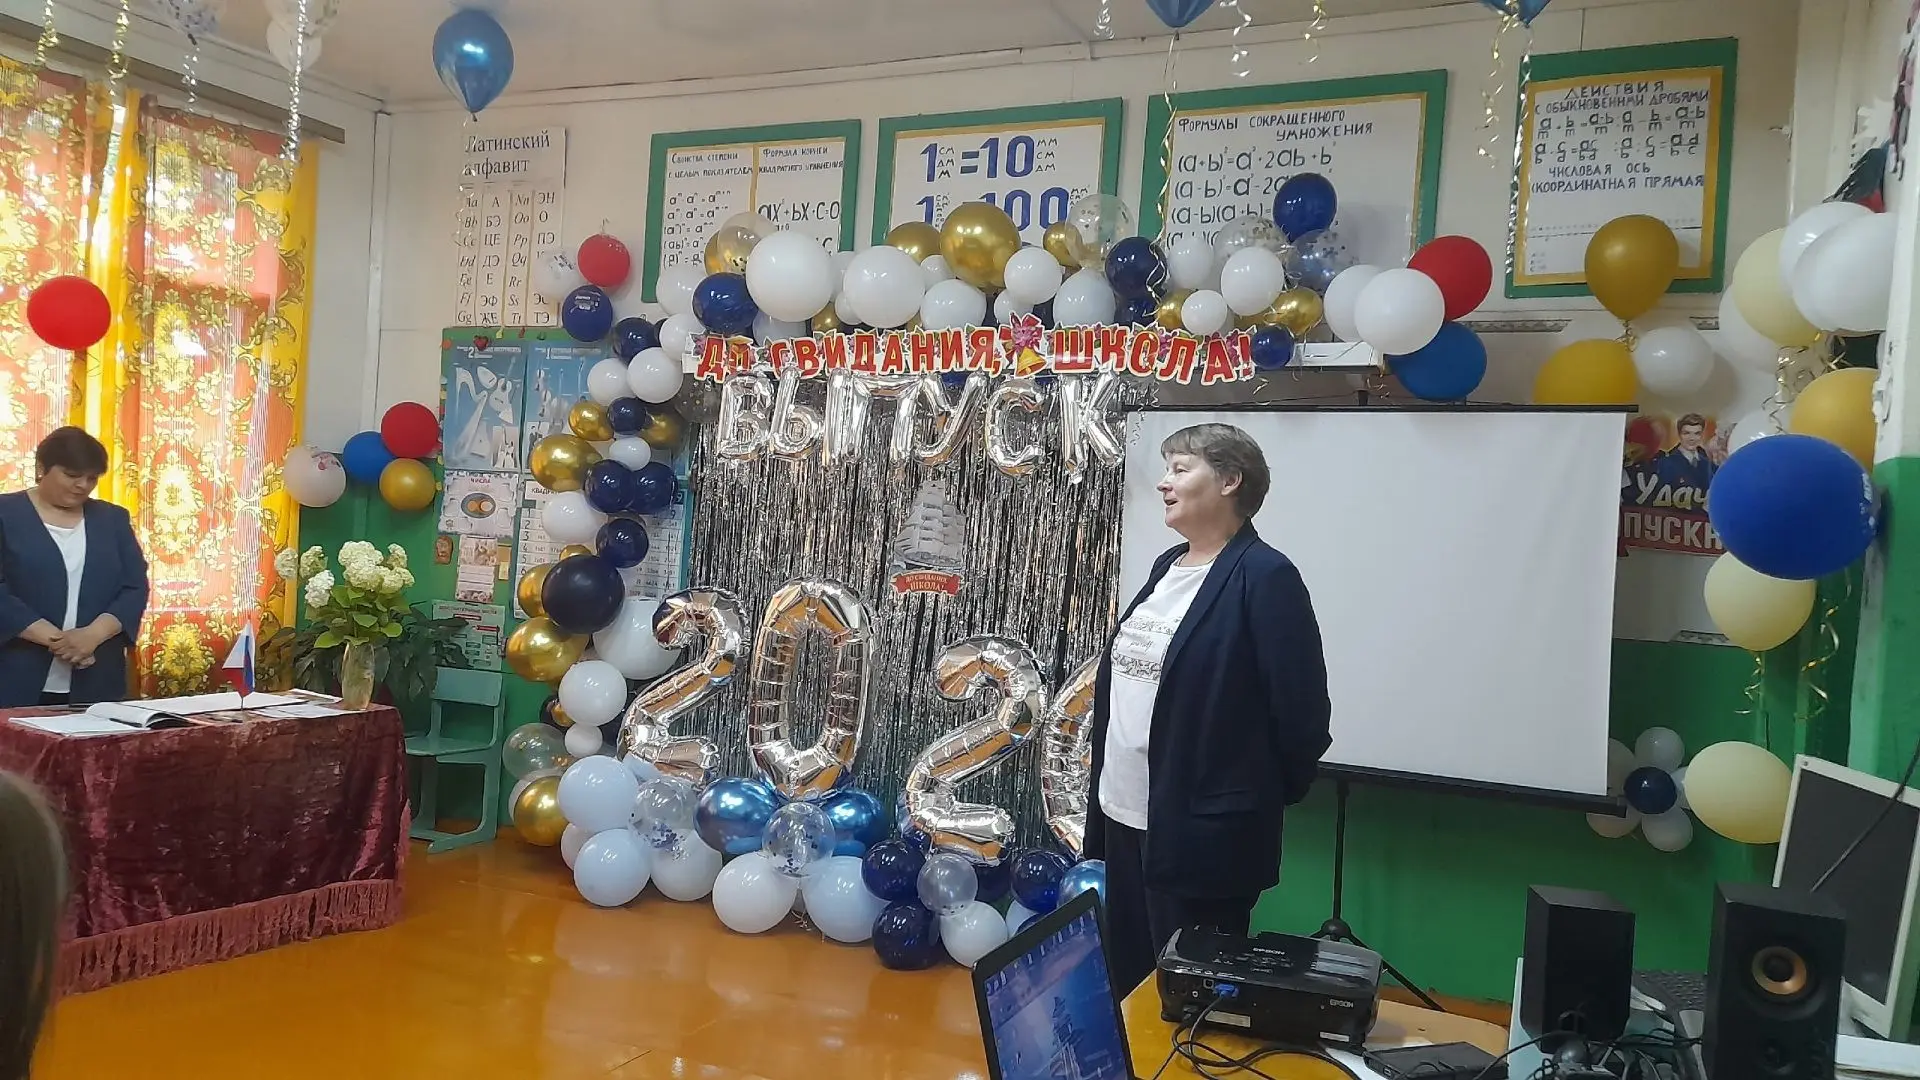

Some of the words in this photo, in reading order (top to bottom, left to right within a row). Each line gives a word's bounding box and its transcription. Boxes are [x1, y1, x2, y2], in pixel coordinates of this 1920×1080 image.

[1249, 110, 1346, 128] СОКРАЩЕННОГО
[464, 129, 550, 153] Латинский
[1276, 122, 1373, 142] УМНОЖЕНИЯ
[980, 136, 1034, 178] 10
[463, 157, 530, 180] алфавит
[1549, 164, 1611, 178] ЧИСЛОВАЯ
[1626, 162, 1651, 174] ОСЬ
[486, 215, 501, 228] БЭ
[537, 232, 555, 245] ПЭ
[482, 254, 500, 269] ДЭ
[480, 295, 498, 307] ЭФ
[533, 311, 550, 324] ТЭ
[696, 335, 752, 382] ДО
[770, 328, 1002, 378] СВИДАНИЯ,
[1053, 328, 1255, 385] ШКОЛА!
[715, 365, 1125, 484] ВЫПУСК
